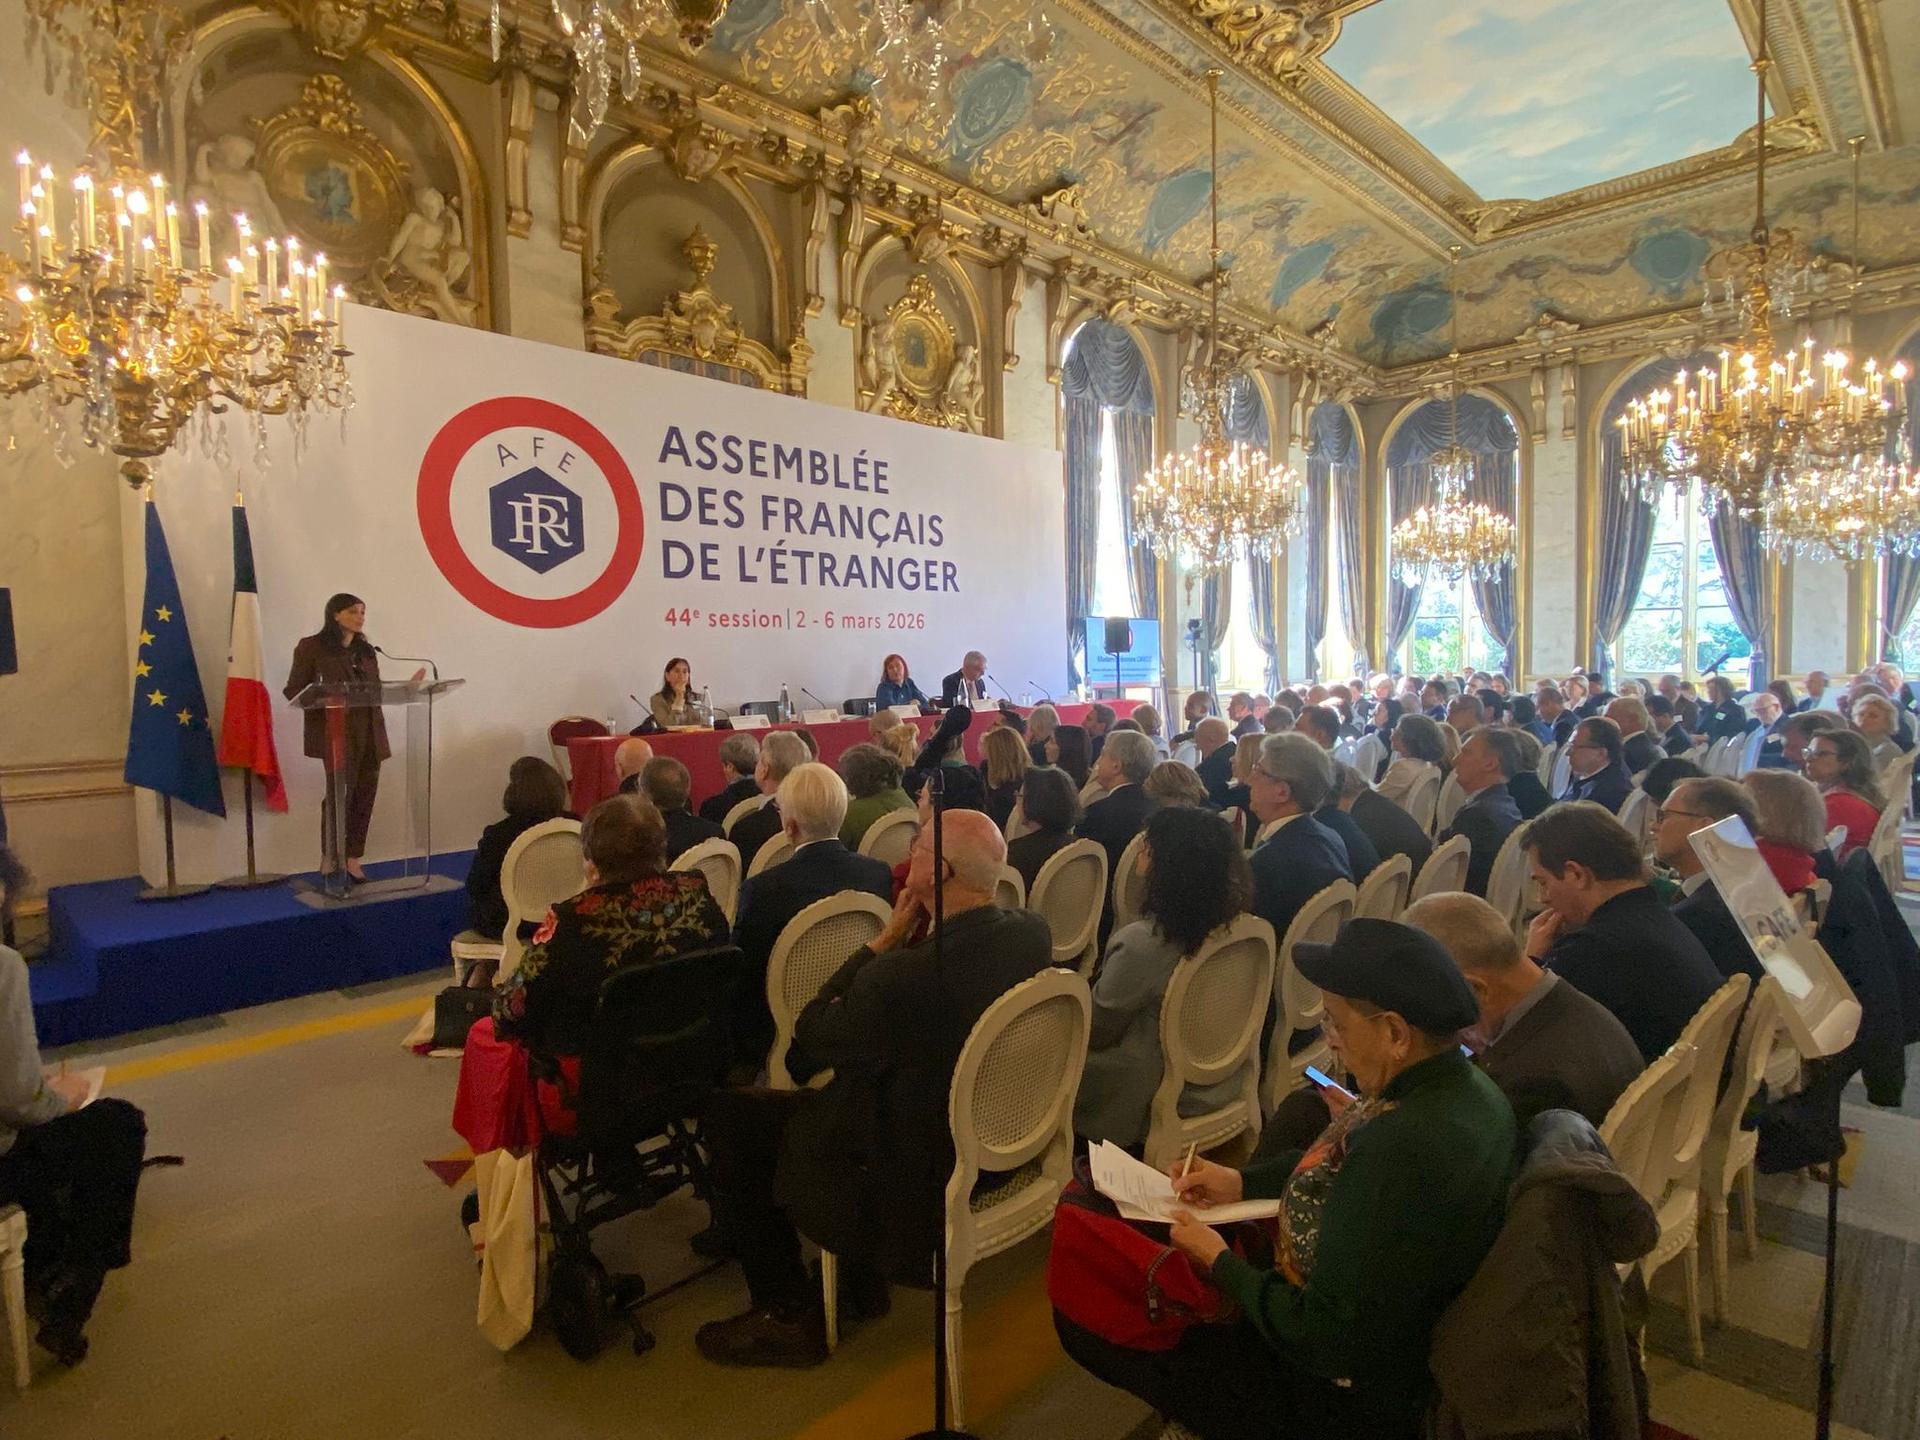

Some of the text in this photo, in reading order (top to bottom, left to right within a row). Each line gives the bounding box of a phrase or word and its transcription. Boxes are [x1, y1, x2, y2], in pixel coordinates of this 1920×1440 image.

[658, 426, 890, 496] ASSEMBLÉE
[658, 482, 945, 549] DES FRANÇAIS
[662, 539, 961, 593] DE L’ÉTRANGER
[708, 609, 783, 628] session
[797, 611, 807, 629] 2
[825, 611, 835, 629] 6
[842, 615, 881, 629] mars
[887, 612, 925, 629] 2026
